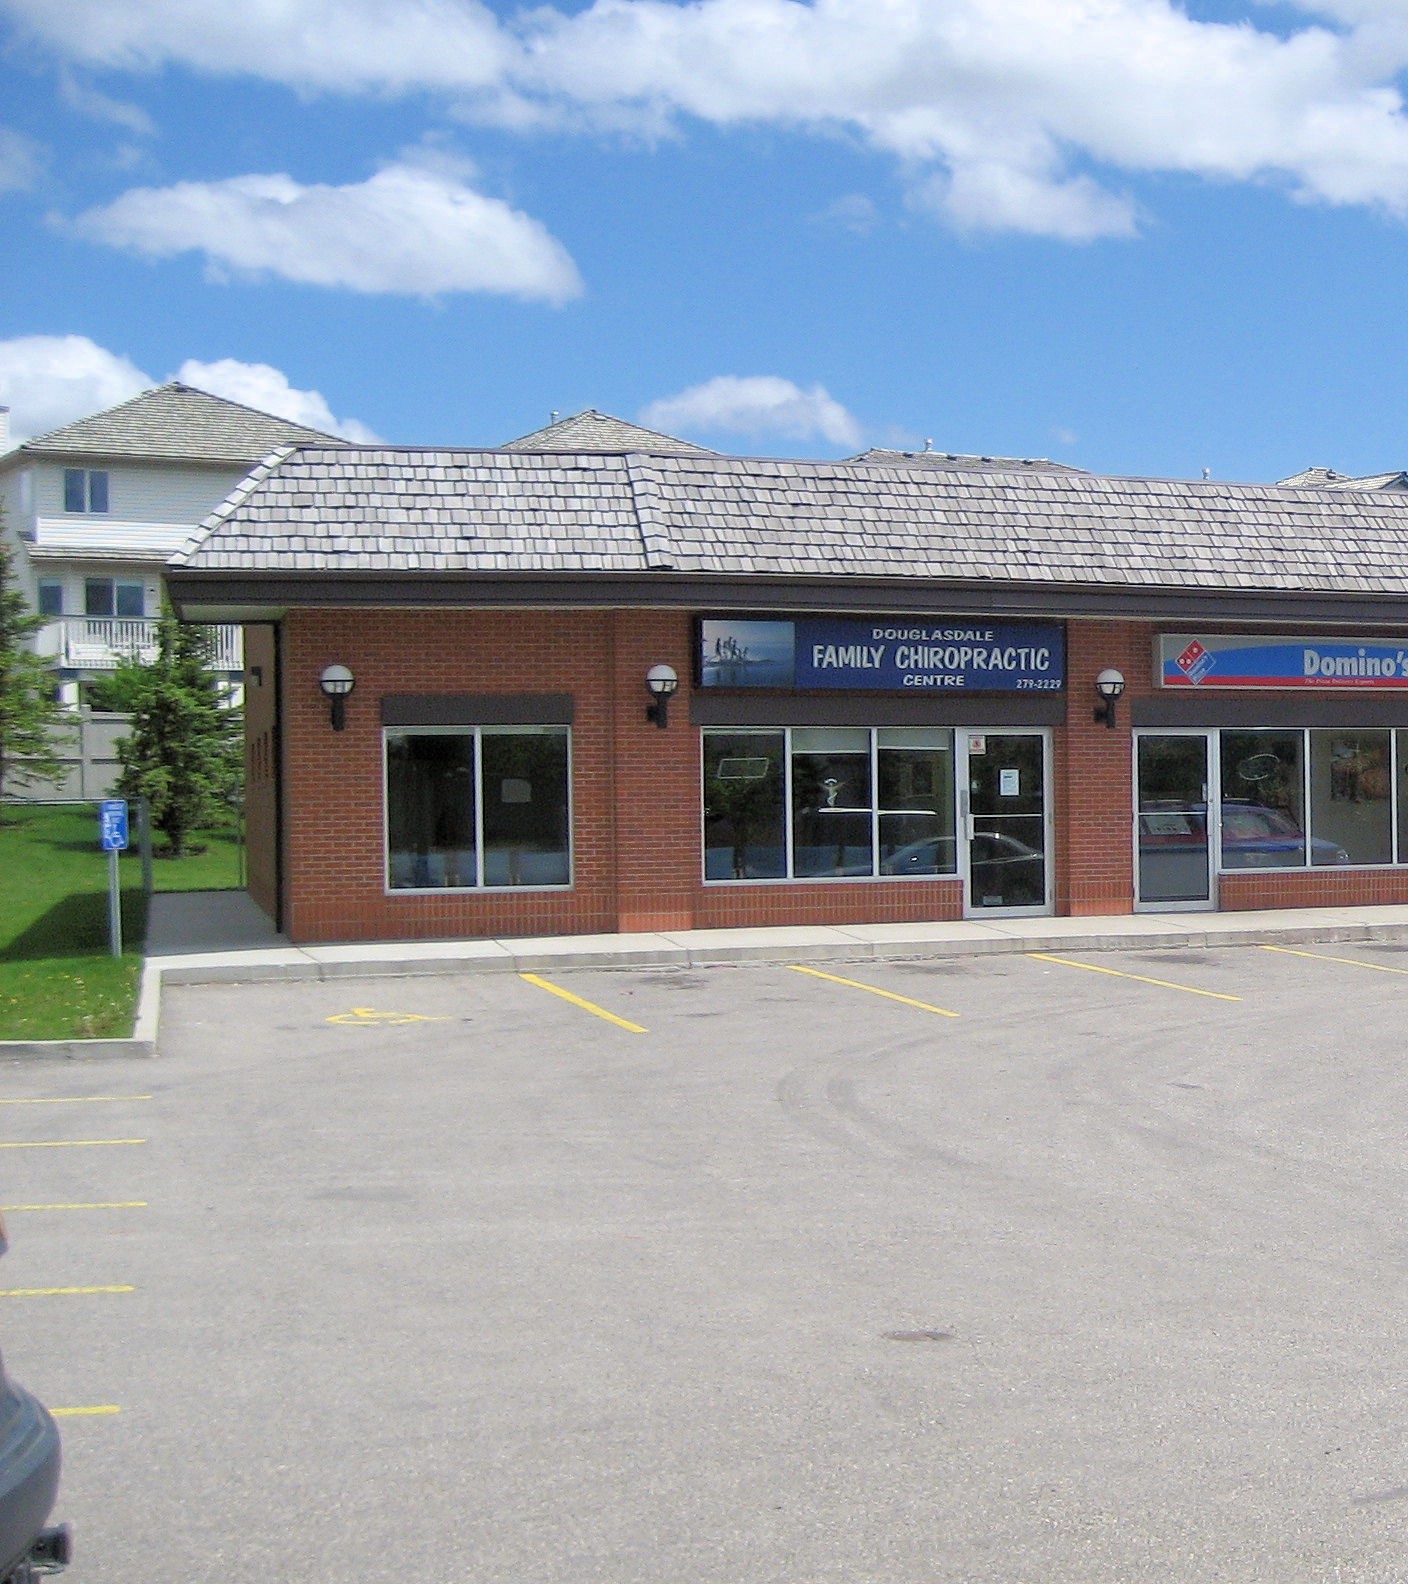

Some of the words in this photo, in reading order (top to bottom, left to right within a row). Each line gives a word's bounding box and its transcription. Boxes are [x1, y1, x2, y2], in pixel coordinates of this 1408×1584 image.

[872, 628, 994, 642] DOUGLASDALE
[812, 644, 885, 669] FAMILY
[895, 645, 1049, 671] CHIROPRACTIC
[903, 674, 965, 687] CENTRE
